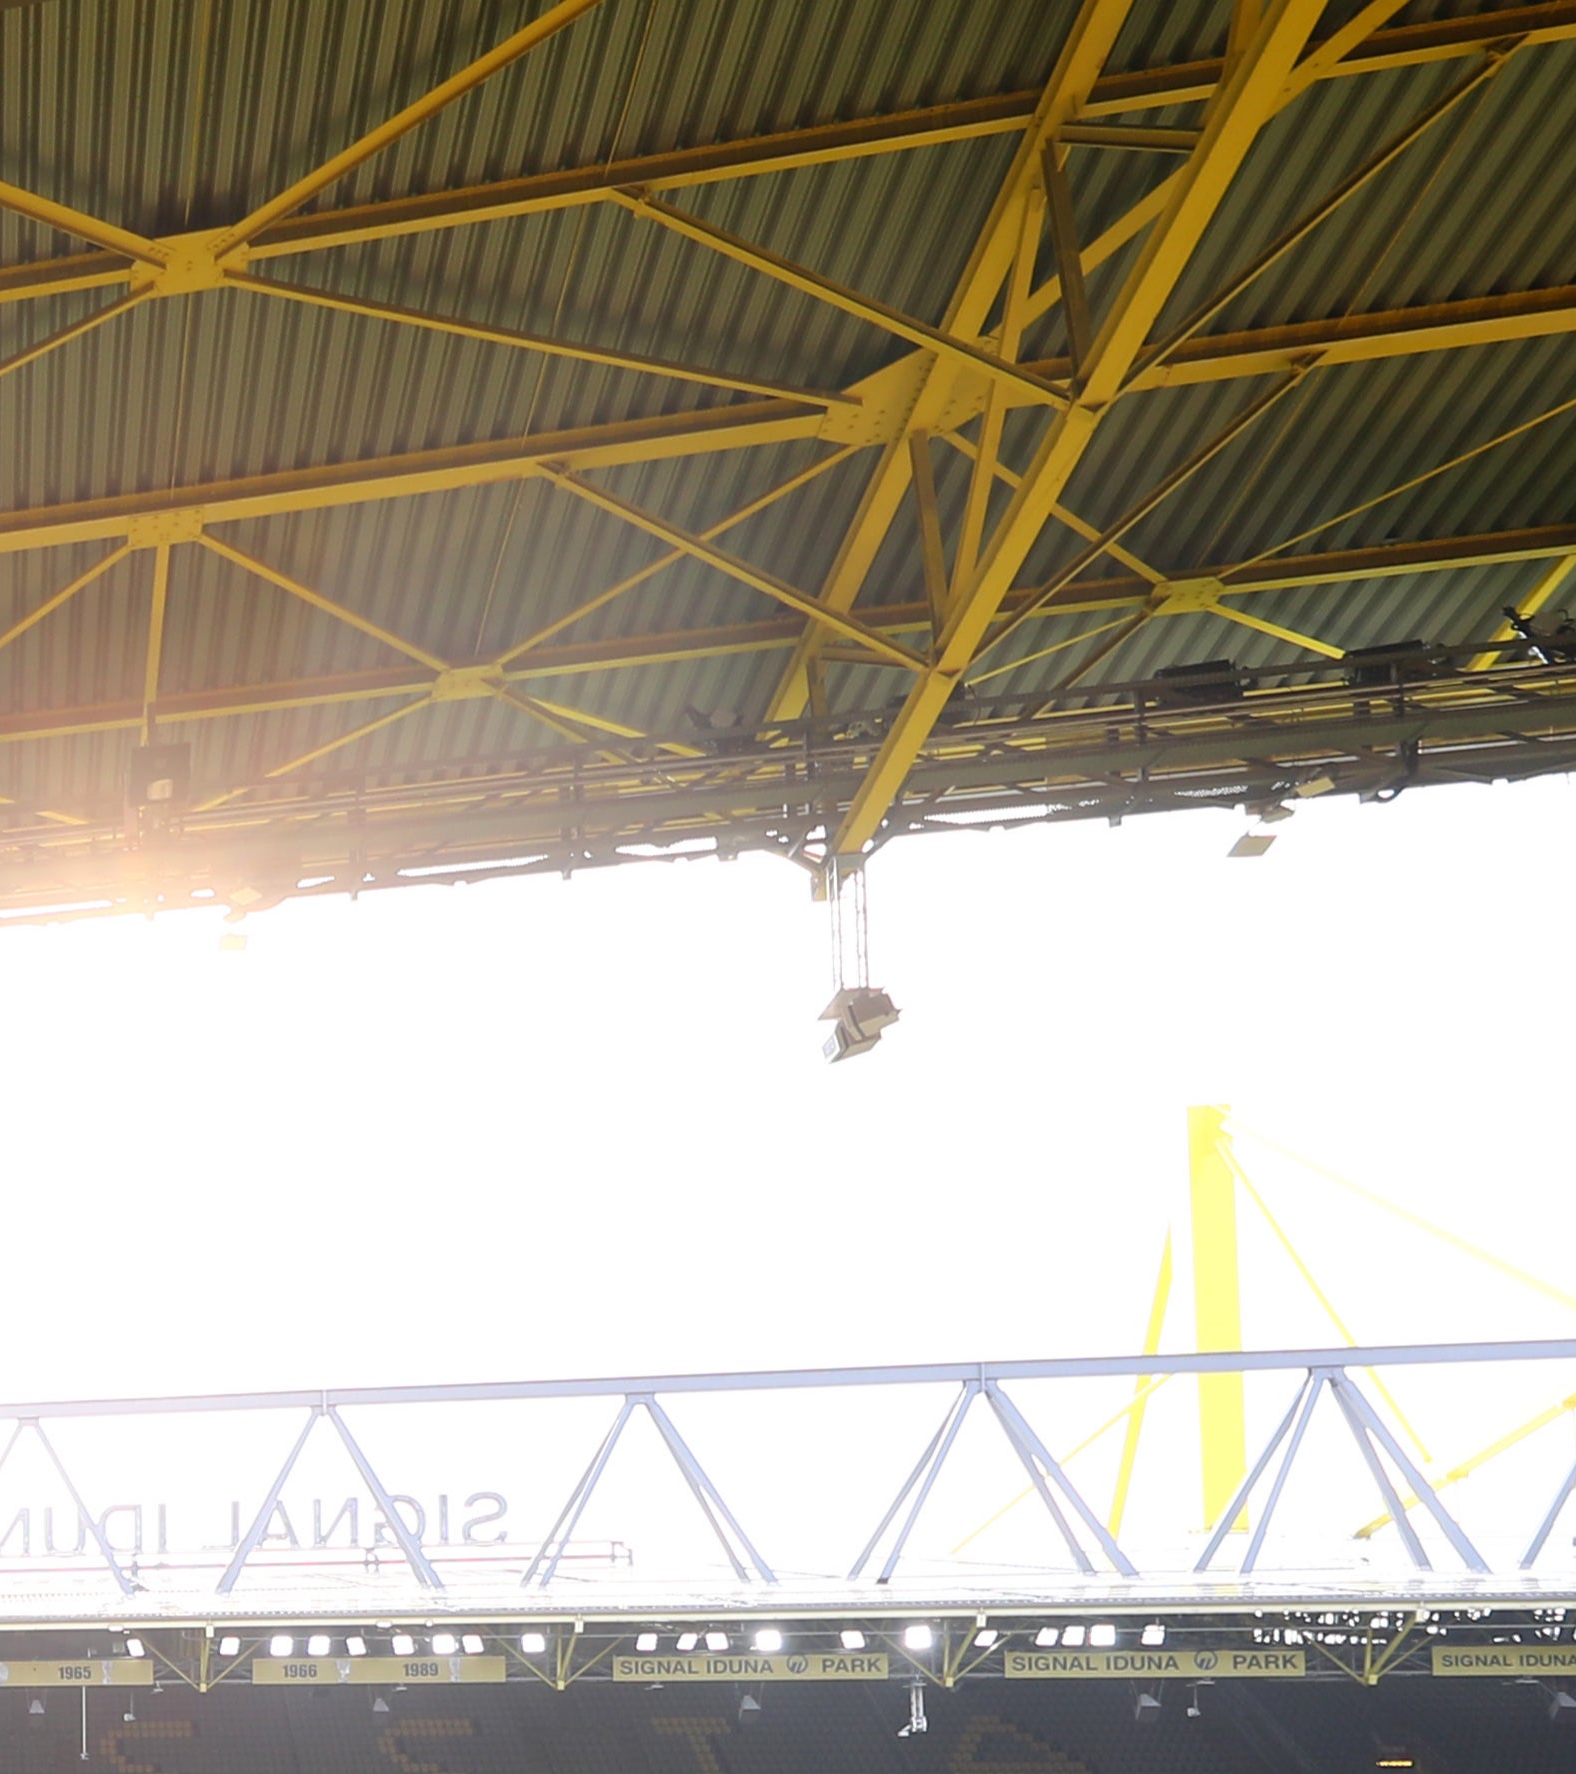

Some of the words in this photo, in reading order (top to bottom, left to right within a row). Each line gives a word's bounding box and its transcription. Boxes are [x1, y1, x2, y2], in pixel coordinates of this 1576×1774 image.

[282, 1664, 317, 1679] 1966
[402, 1662, 439, 1678] 1989
[619, 1660, 699, 1675] SIGNAL
[706, 1659, 774, 1674] IDUNA
[821, 1657, 882, 1673] PARK
[1012, 1655, 1099, 1672] SIGNAL
[1105, 1654, 1179, 1671] IDUNA
[1232, 1653, 1298, 1670] PARK
[57, 1664, 92, 1680] 1965
